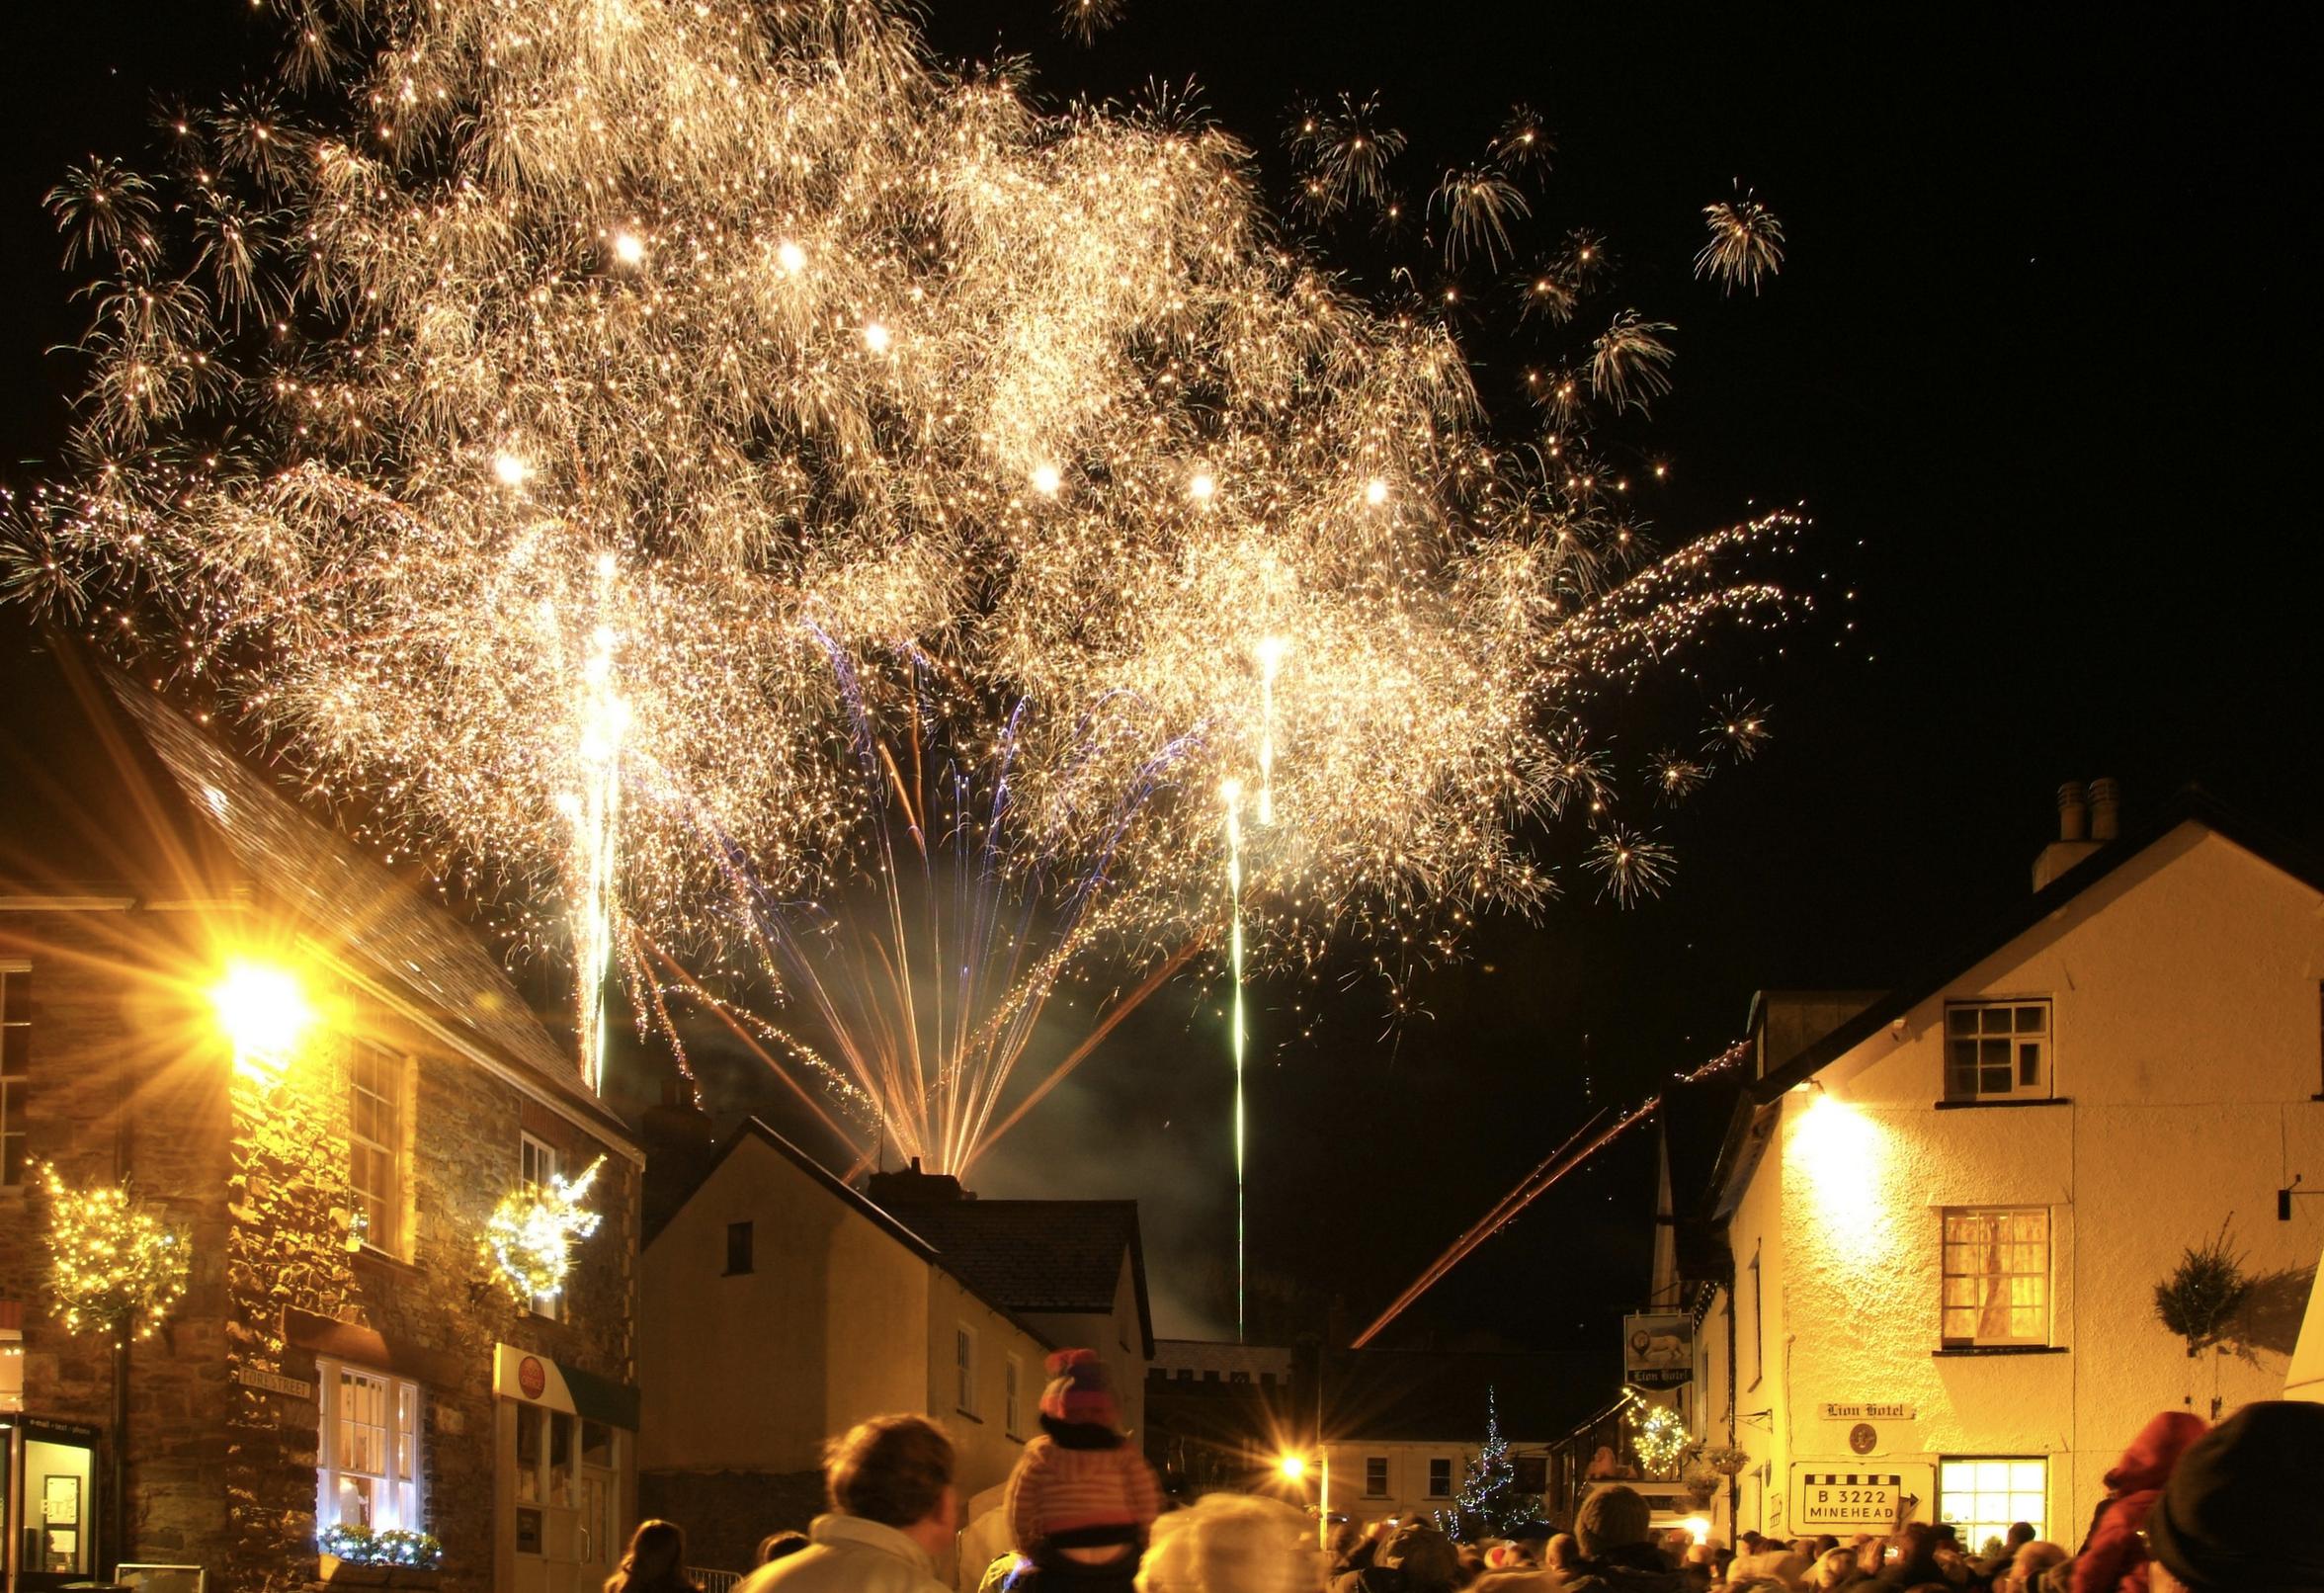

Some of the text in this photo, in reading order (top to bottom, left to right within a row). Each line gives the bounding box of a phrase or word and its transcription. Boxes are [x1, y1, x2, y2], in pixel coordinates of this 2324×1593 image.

[1634, 1369, 1688, 1383] Lion Hotel
[268, 1374, 305, 1395] STREET
[1827, 1403, 1904, 1417] Lion Hotel
[1819, 1490, 1886, 1503] B 3222
[1810, 1507, 1894, 1518] MINEHEAD
